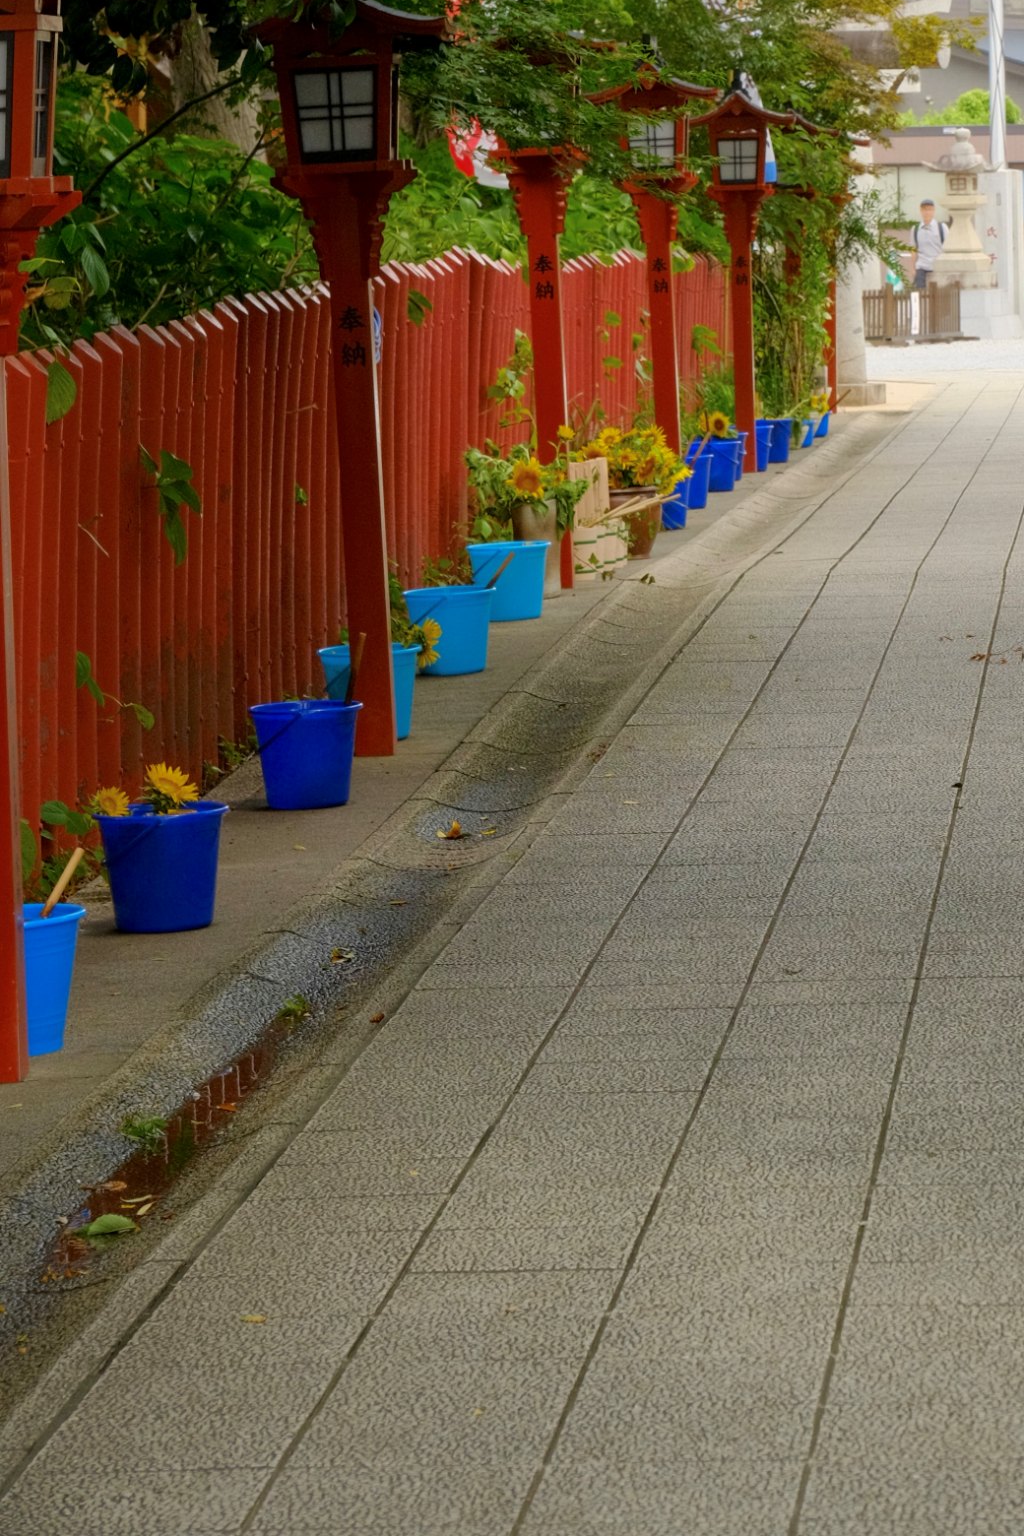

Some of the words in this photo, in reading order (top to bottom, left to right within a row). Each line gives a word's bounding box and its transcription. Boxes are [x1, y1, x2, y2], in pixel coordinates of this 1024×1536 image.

[534, 253, 554, 300] 奉納
[652, 256, 669, 294] 奉納
[339, 305, 367, 368] 奉納
